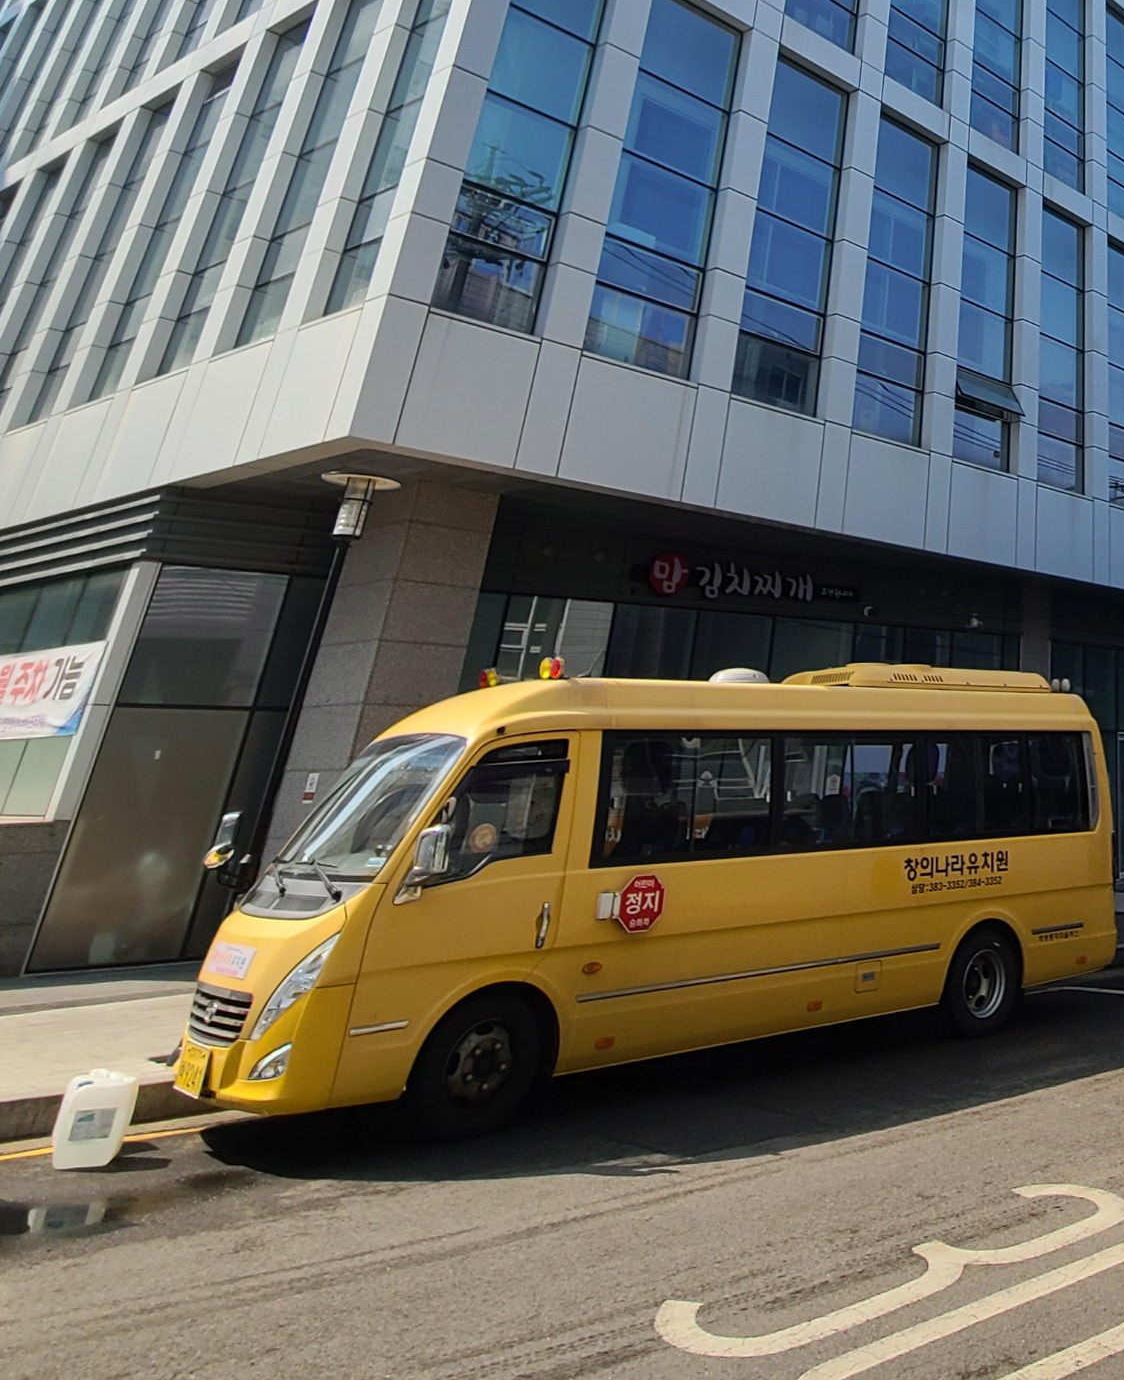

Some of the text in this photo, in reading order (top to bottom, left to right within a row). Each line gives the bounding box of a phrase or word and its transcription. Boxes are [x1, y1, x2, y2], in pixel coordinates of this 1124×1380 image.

[695, 562, 813, 602] 김치찌개
[42, 656, 85, 701] 가능
[625, 890, 660, 914] 정지
